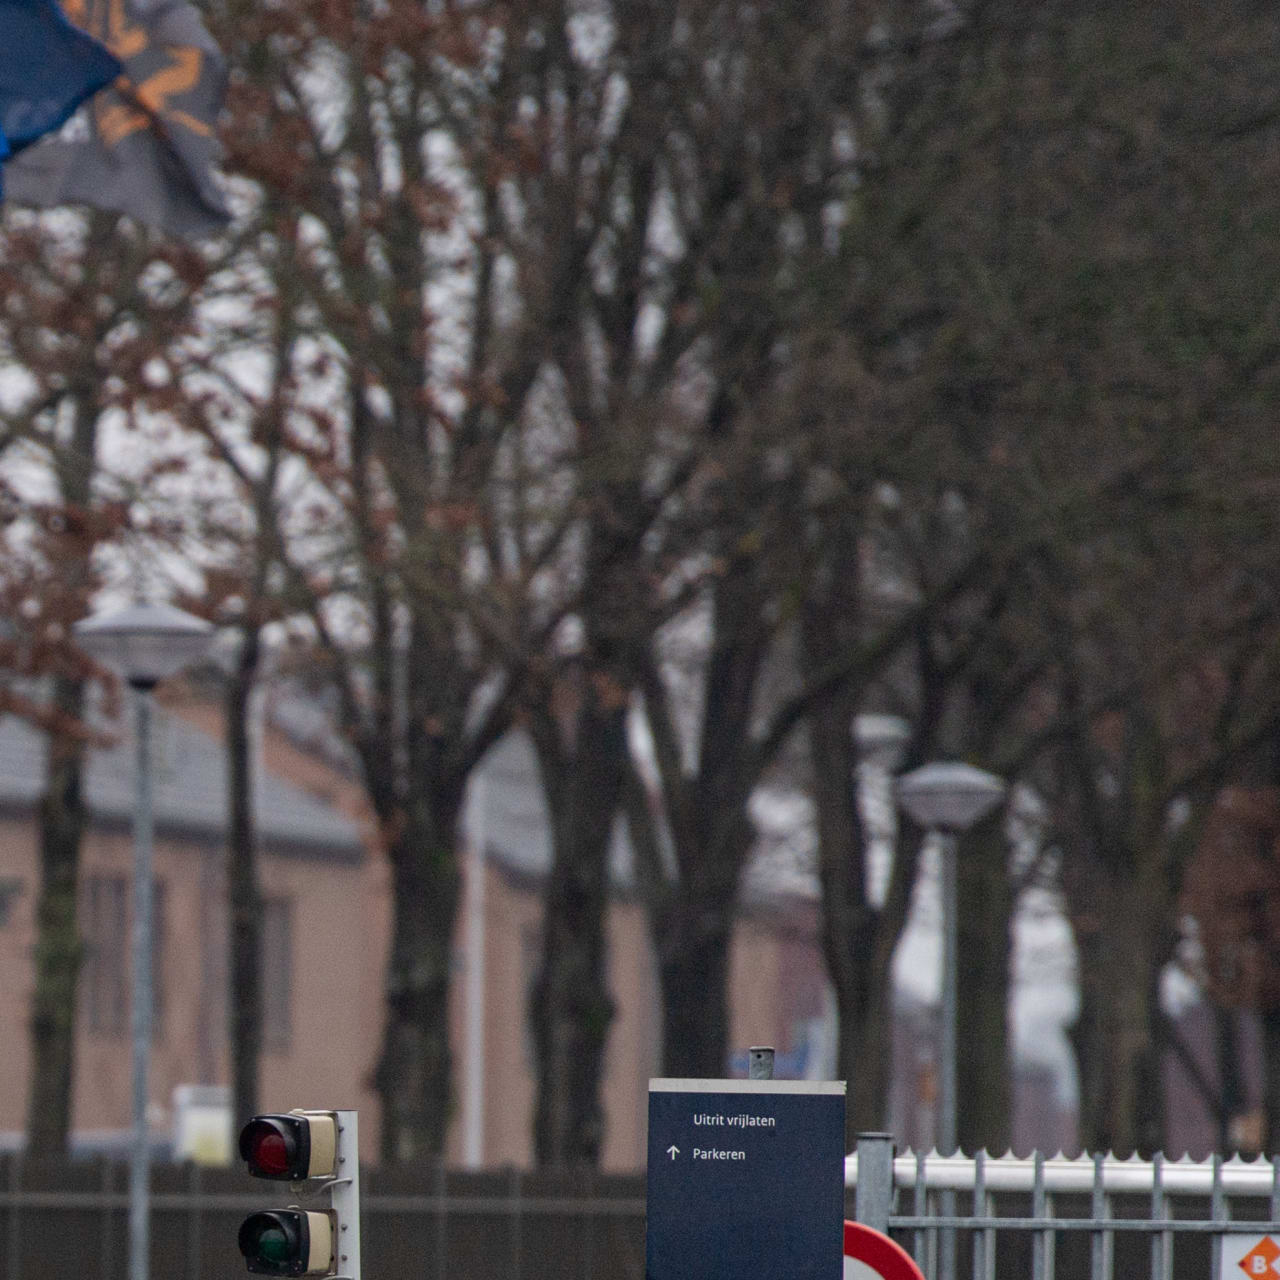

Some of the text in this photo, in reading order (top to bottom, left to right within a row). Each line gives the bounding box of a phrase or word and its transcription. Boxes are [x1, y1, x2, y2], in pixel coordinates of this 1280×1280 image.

[693, 1113, 776, 1129] Uitrit vrijlaten
[693, 1147, 746, 1160] Parkeren
